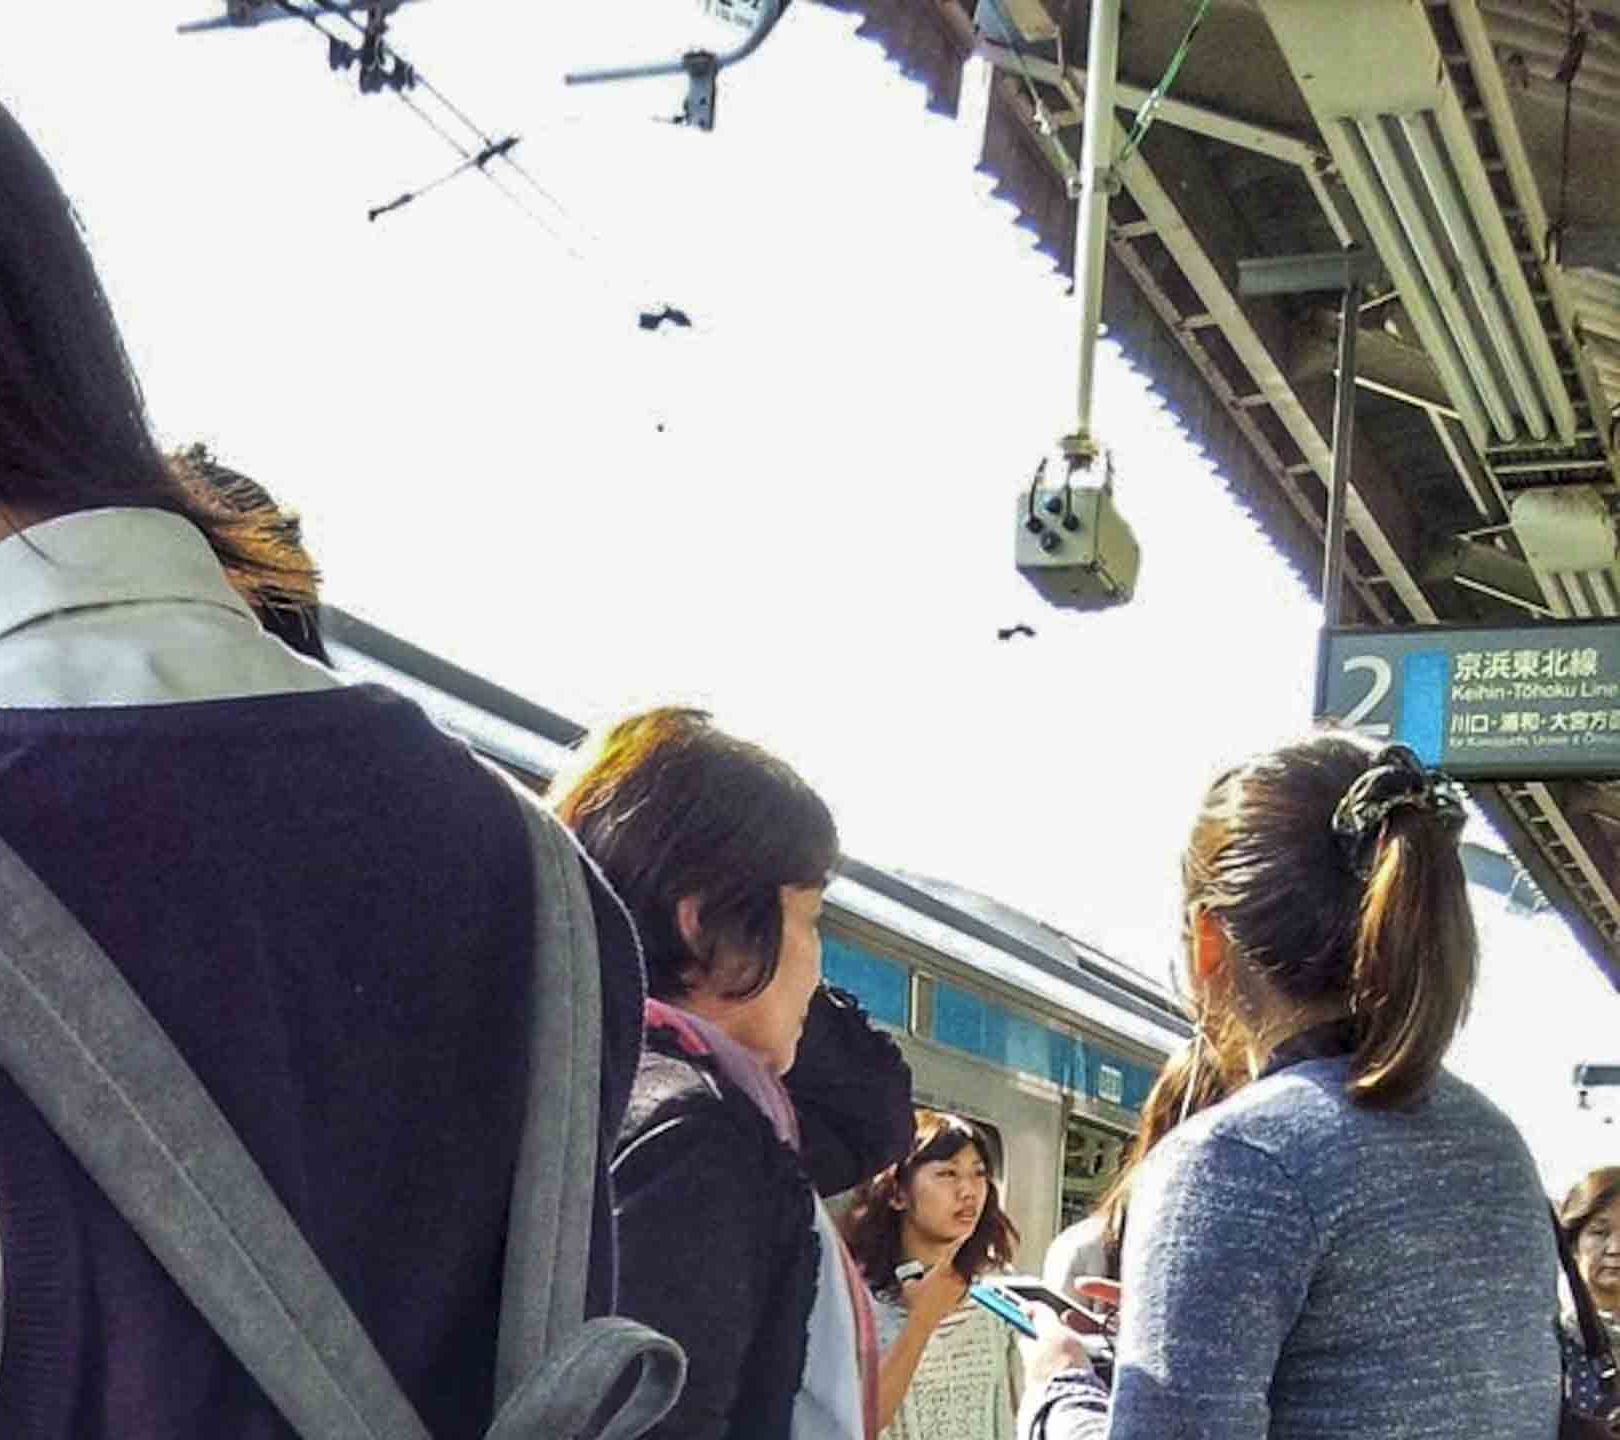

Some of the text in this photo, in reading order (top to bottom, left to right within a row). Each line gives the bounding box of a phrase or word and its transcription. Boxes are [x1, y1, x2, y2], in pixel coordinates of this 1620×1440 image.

[1454, 648, 1597, 681] 京浜東北線
[1340, 655, 1391, 736] 2
